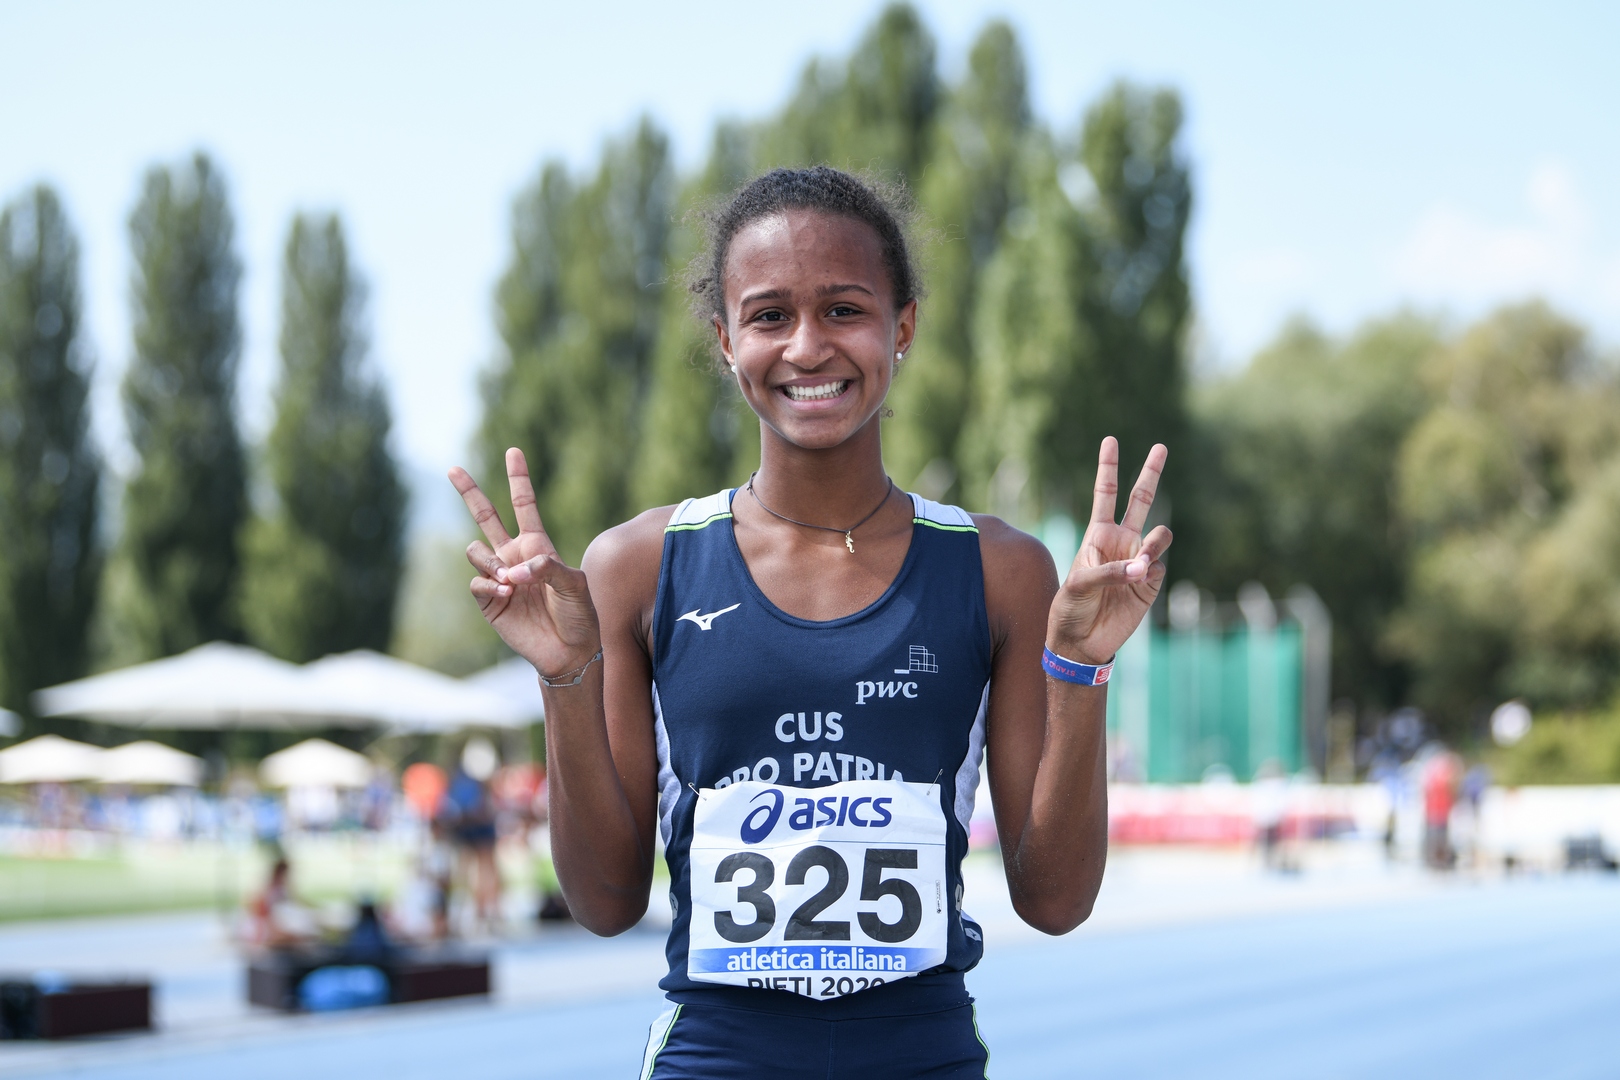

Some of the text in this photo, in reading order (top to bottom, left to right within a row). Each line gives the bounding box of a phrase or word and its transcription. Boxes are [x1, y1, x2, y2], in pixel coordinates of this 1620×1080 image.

[855, 680, 918, 705] pwc
[774, 711, 844, 743] CUS
[713, 845, 923, 944] 325
[726, 946, 907, 971] atletica italiana
